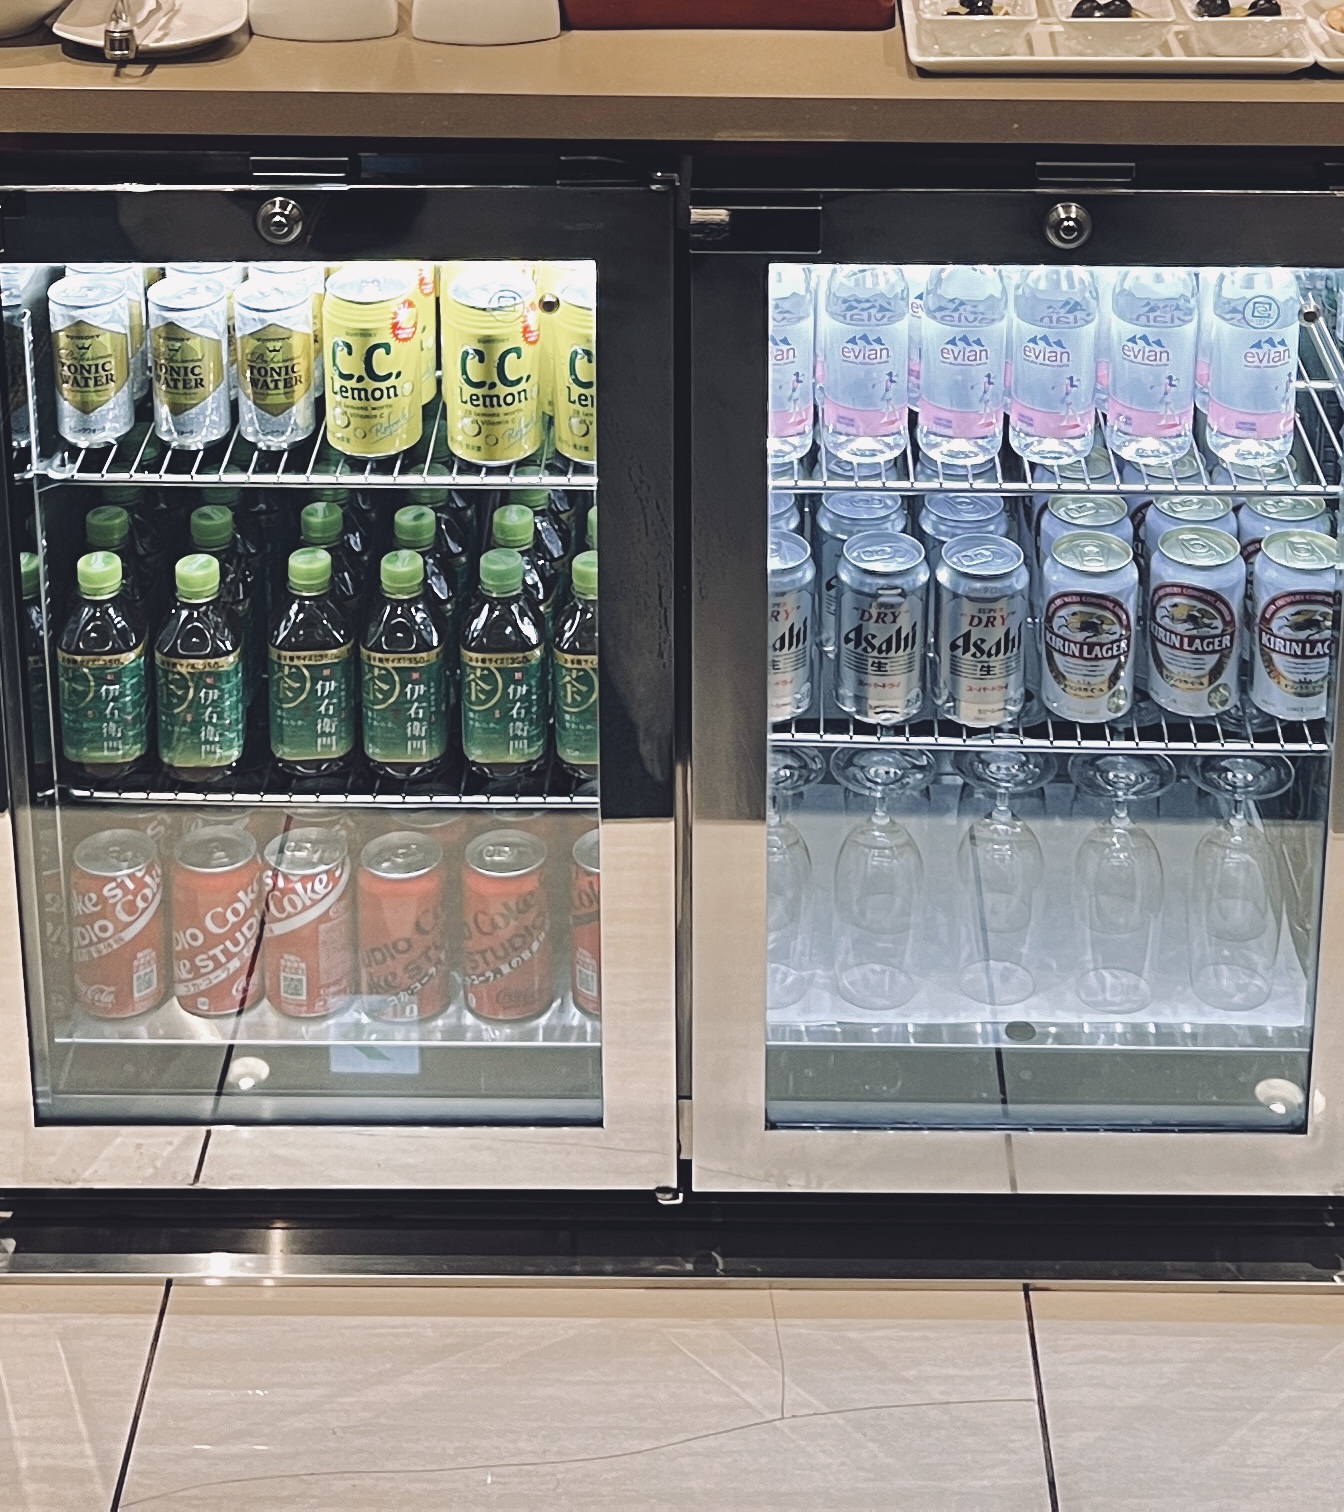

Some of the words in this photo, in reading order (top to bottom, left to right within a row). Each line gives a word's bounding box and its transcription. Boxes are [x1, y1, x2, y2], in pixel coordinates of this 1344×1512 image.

[331, 339, 403, 383] C.C.
[770, 345, 797, 362] ian
[841, 345, 890, 363] evian
[940, 346, 989, 363] evian
[1023, 343, 1071, 364] evian
[1121, 344, 1170, 364] evian
[1244, 346, 1291, 365] evian
[157, 363, 203, 378] ONIC
[250, 361, 301, 377] TONIC
[460, 345, 532, 390] C.C.
[158, 375, 205, 390] ATER
[330, 376, 399, 403] Lemon
[458, 385, 529, 409] Lemon
[770, 607, 794, 622] RY
[859, 608, 902, 624] DRY
[968, 613, 1009, 629] DRY
[772, 616, 808, 653] ahi
[843, 620, 918, 655] Asahi
[949, 619, 1022, 659] Asahi
[1045, 632, 1082, 657] KIRIN
[1082, 639, 1129, 659] LAGER
[1182, 634, 1232, 652] LAGER
[1261, 633, 1304, 656] KIRIN
[870, 660, 889, 673] 生
[979, 663, 998, 676] 生
[315, 680, 338, 752] 伊右衛門
[405, 683, 427, 756] 伊右衛門
[508, 684, 529, 756] 伊右衛門
[115, 868, 161, 922] Cok
[269, 872, 333, 919] Coke
[195, 916, 259, 974] STUD
